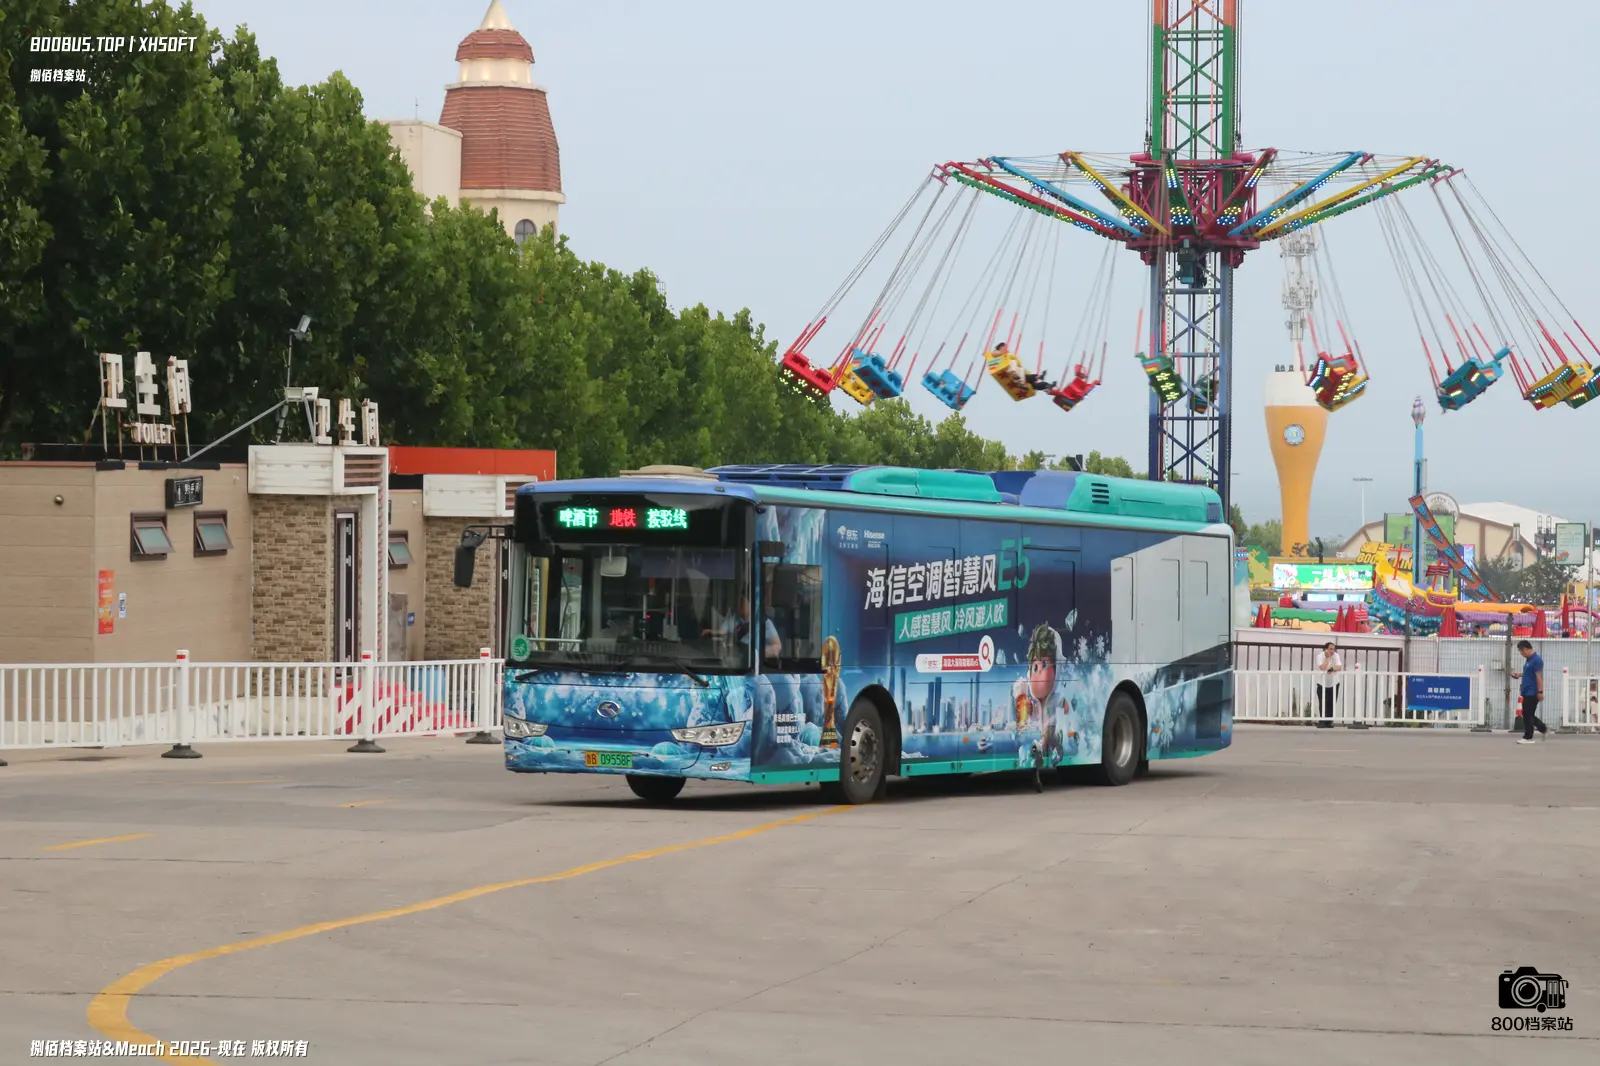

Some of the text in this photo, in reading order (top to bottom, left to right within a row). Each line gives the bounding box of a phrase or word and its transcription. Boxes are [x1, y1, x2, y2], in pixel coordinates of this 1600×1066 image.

[100, 351, 191, 416] 卫生间
[130, 422, 176, 444] TOILET
[559, 508, 688, 529] 啤酒节 地铁 接驳线
[863, 529, 885, 540] Hisense
[899, 610, 952, 640] 人感智慧风
